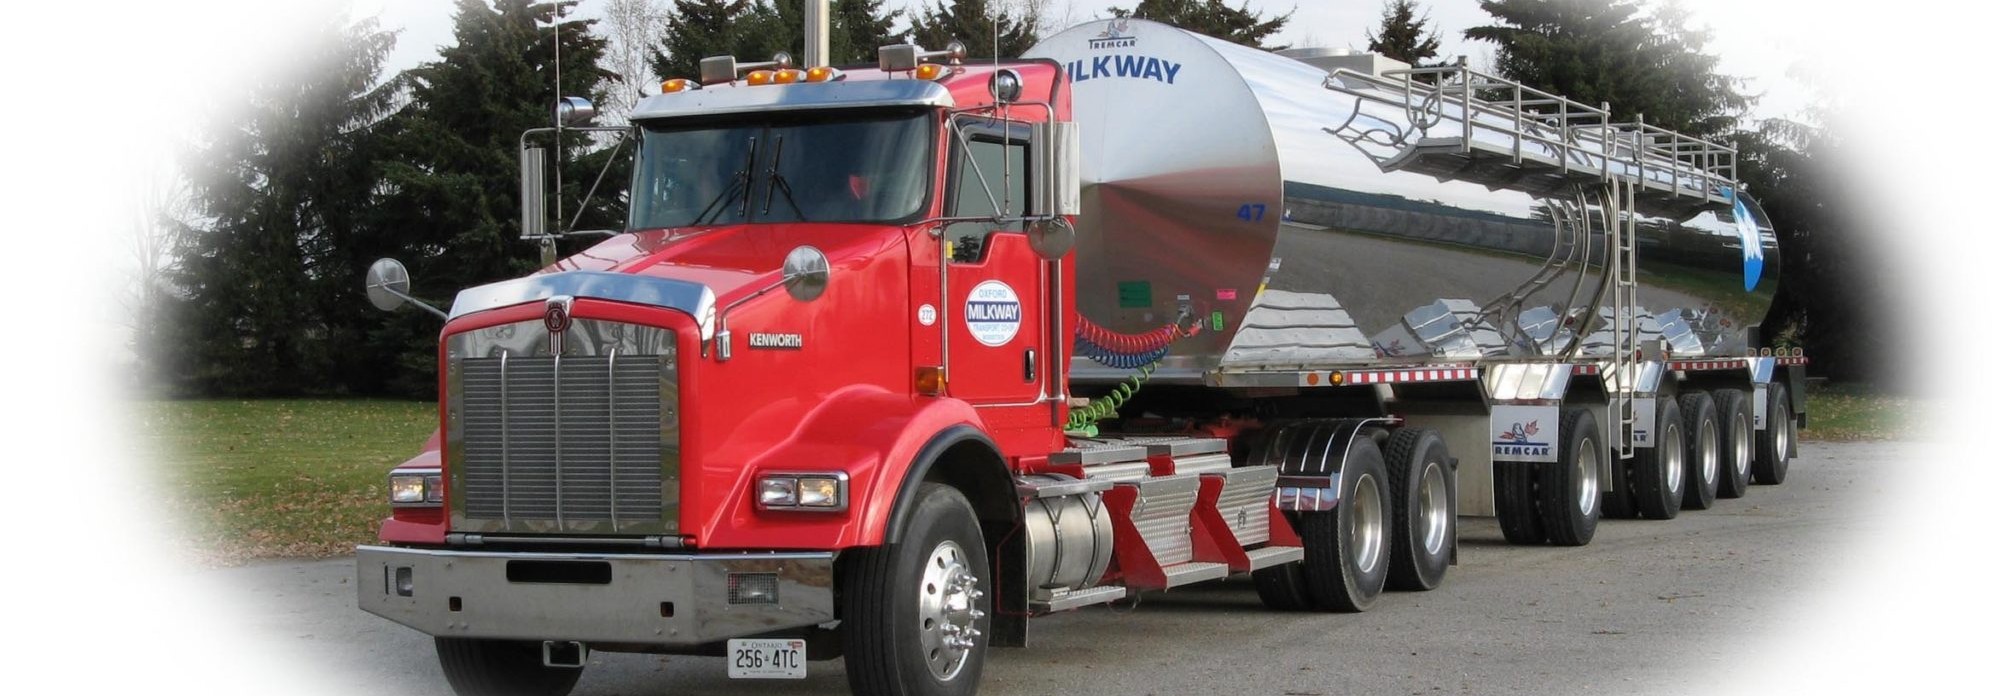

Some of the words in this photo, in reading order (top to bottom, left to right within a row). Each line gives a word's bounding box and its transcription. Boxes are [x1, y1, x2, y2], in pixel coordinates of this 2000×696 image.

[1088, 38, 1136, 50] TREMCAR
[1066, 55, 1182, 84] ILKWAY
[1236, 204, 1265, 222] 47
[979, 289, 1008, 299] OXFORD
[922, 309, 933, 320] 272
[968, 304, 1018, 320] MILKWAY
[749, 333, 802, 347] KENWORTH
[1494, 446, 1550, 456] REMCAR
[736, 649, 763, 668] 256
[772, 649, 799, 668] 4TC
